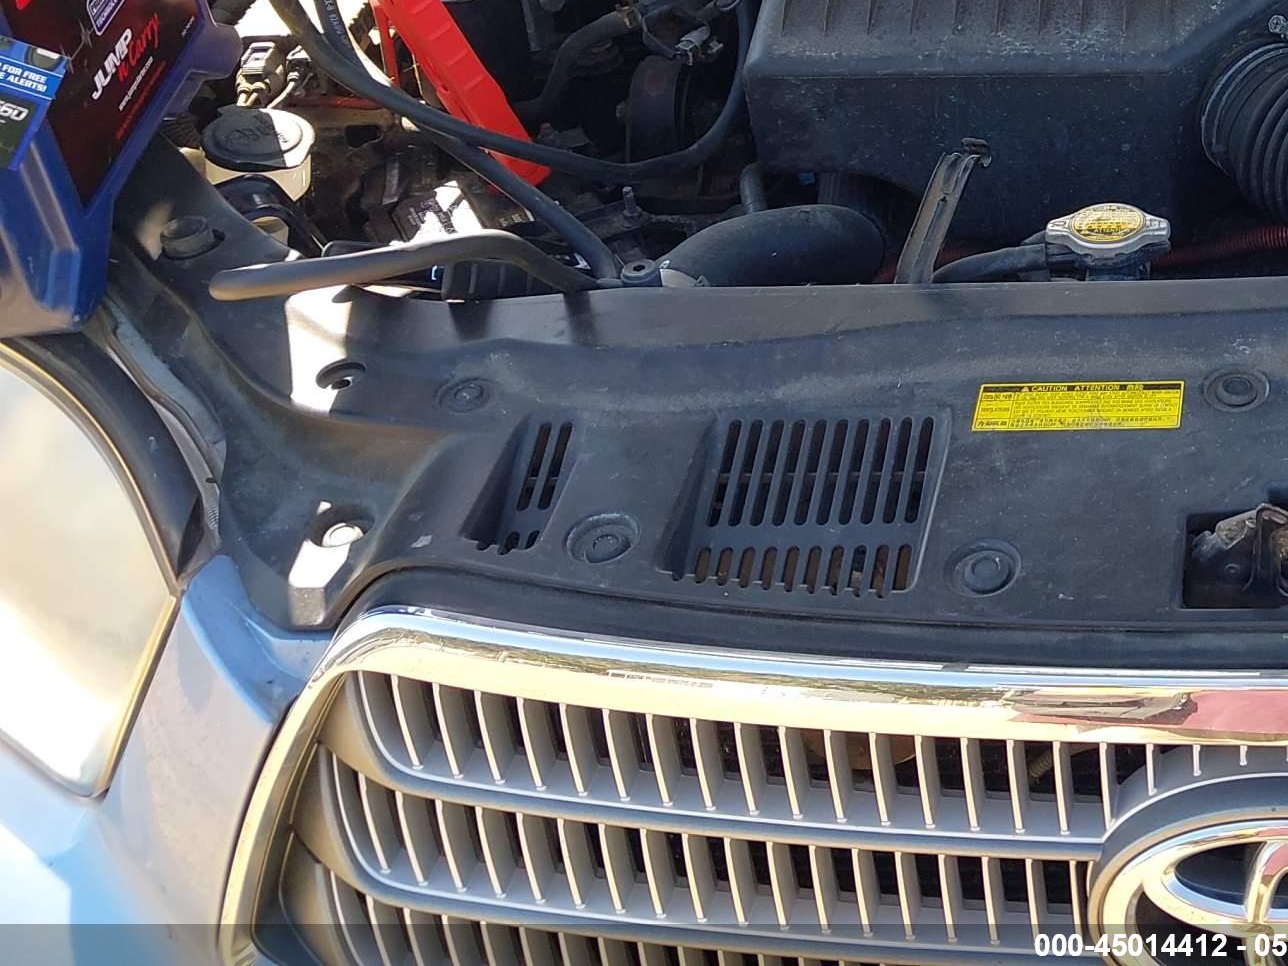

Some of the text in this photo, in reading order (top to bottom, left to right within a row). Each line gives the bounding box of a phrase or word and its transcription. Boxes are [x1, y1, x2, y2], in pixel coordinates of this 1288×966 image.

[2, 63, 22, 78] FOR
[22, 68, 48, 84] FREE
[91, 27, 133, 100] JUMP
[7, 75, 47, 93] ALERTS!
